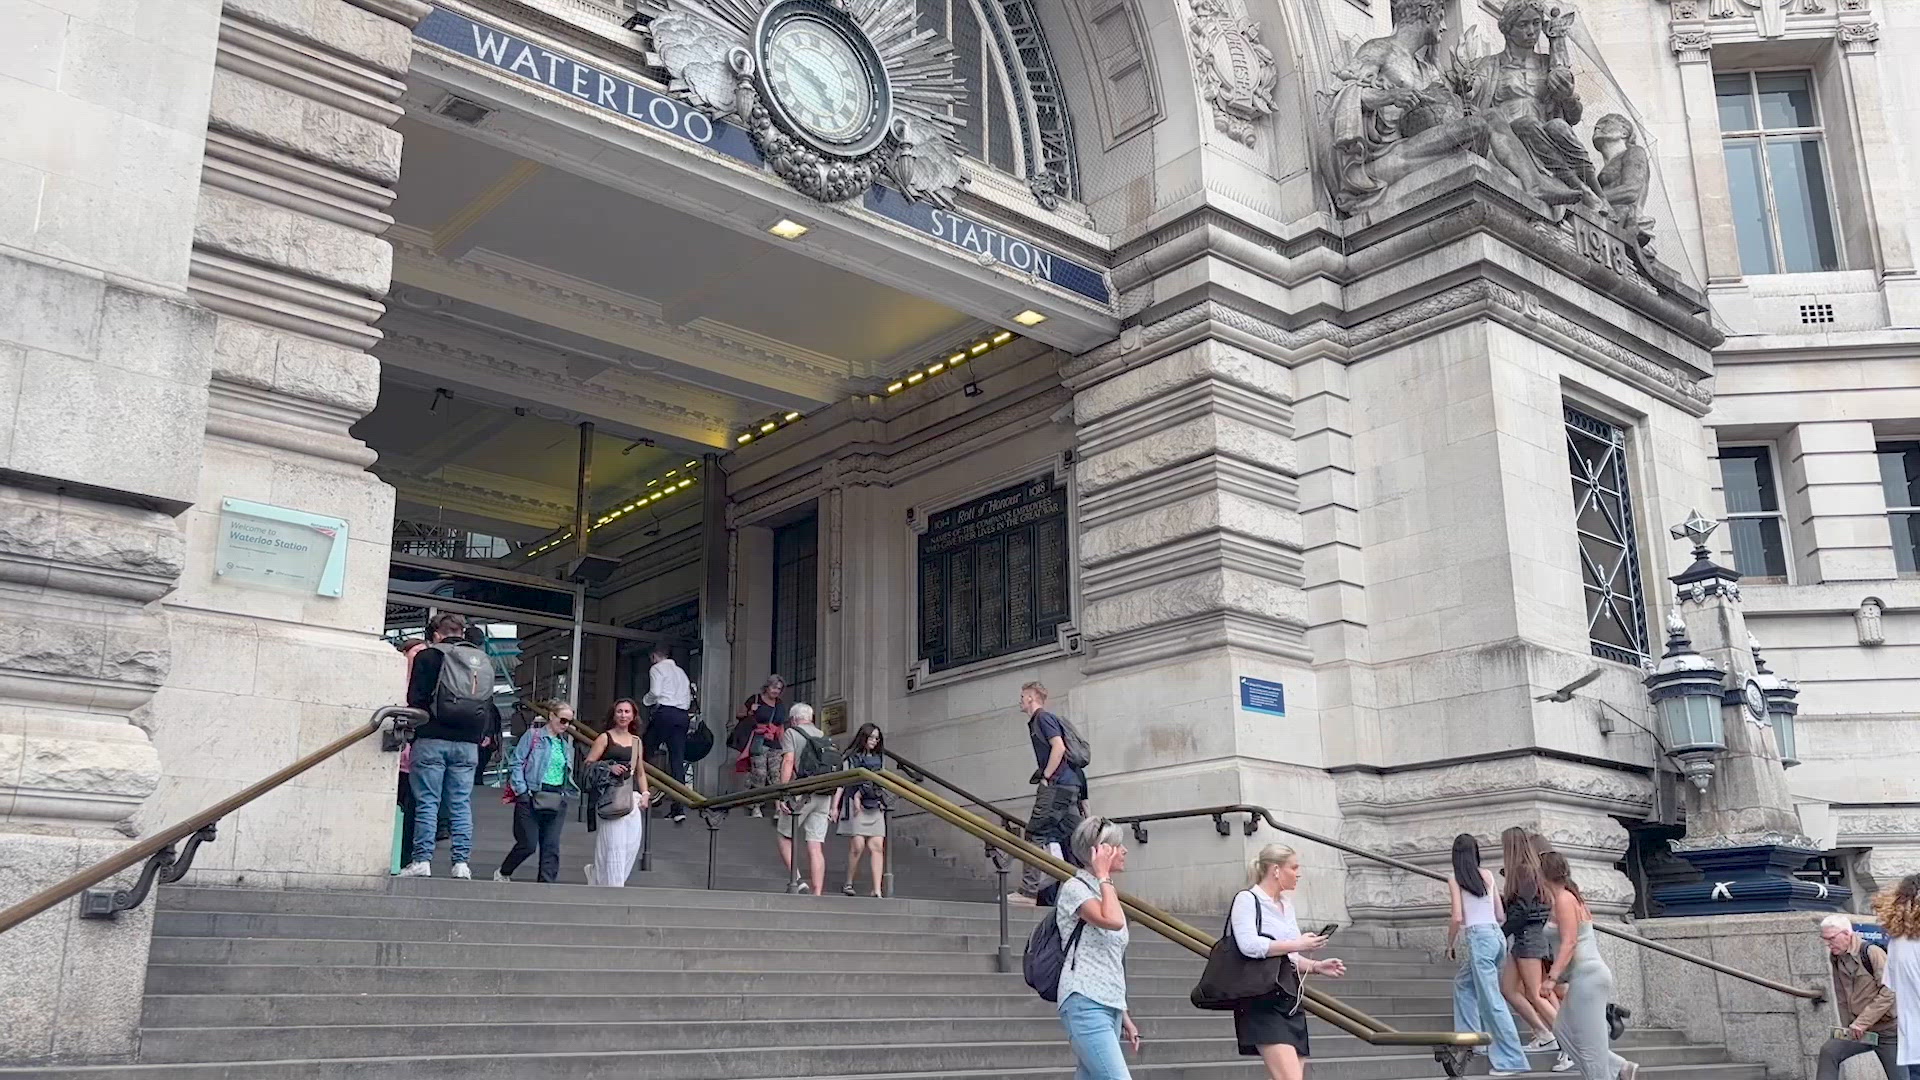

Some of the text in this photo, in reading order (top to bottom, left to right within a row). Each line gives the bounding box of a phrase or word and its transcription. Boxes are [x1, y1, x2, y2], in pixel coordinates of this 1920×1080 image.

[470, 23, 713, 144] WATERLOO
[931, 209, 1052, 282] STATION
[1580, 225, 1624, 275] 1918
[957, 507, 976, 524] Roll
[988, 493, 1022, 513] Honour
[1019, 507, 1043, 524] GREAT
[231, 520, 267, 535] Welcome
[230, 531, 273, 546] Waterloo
[274, 539, 308, 552] Station
